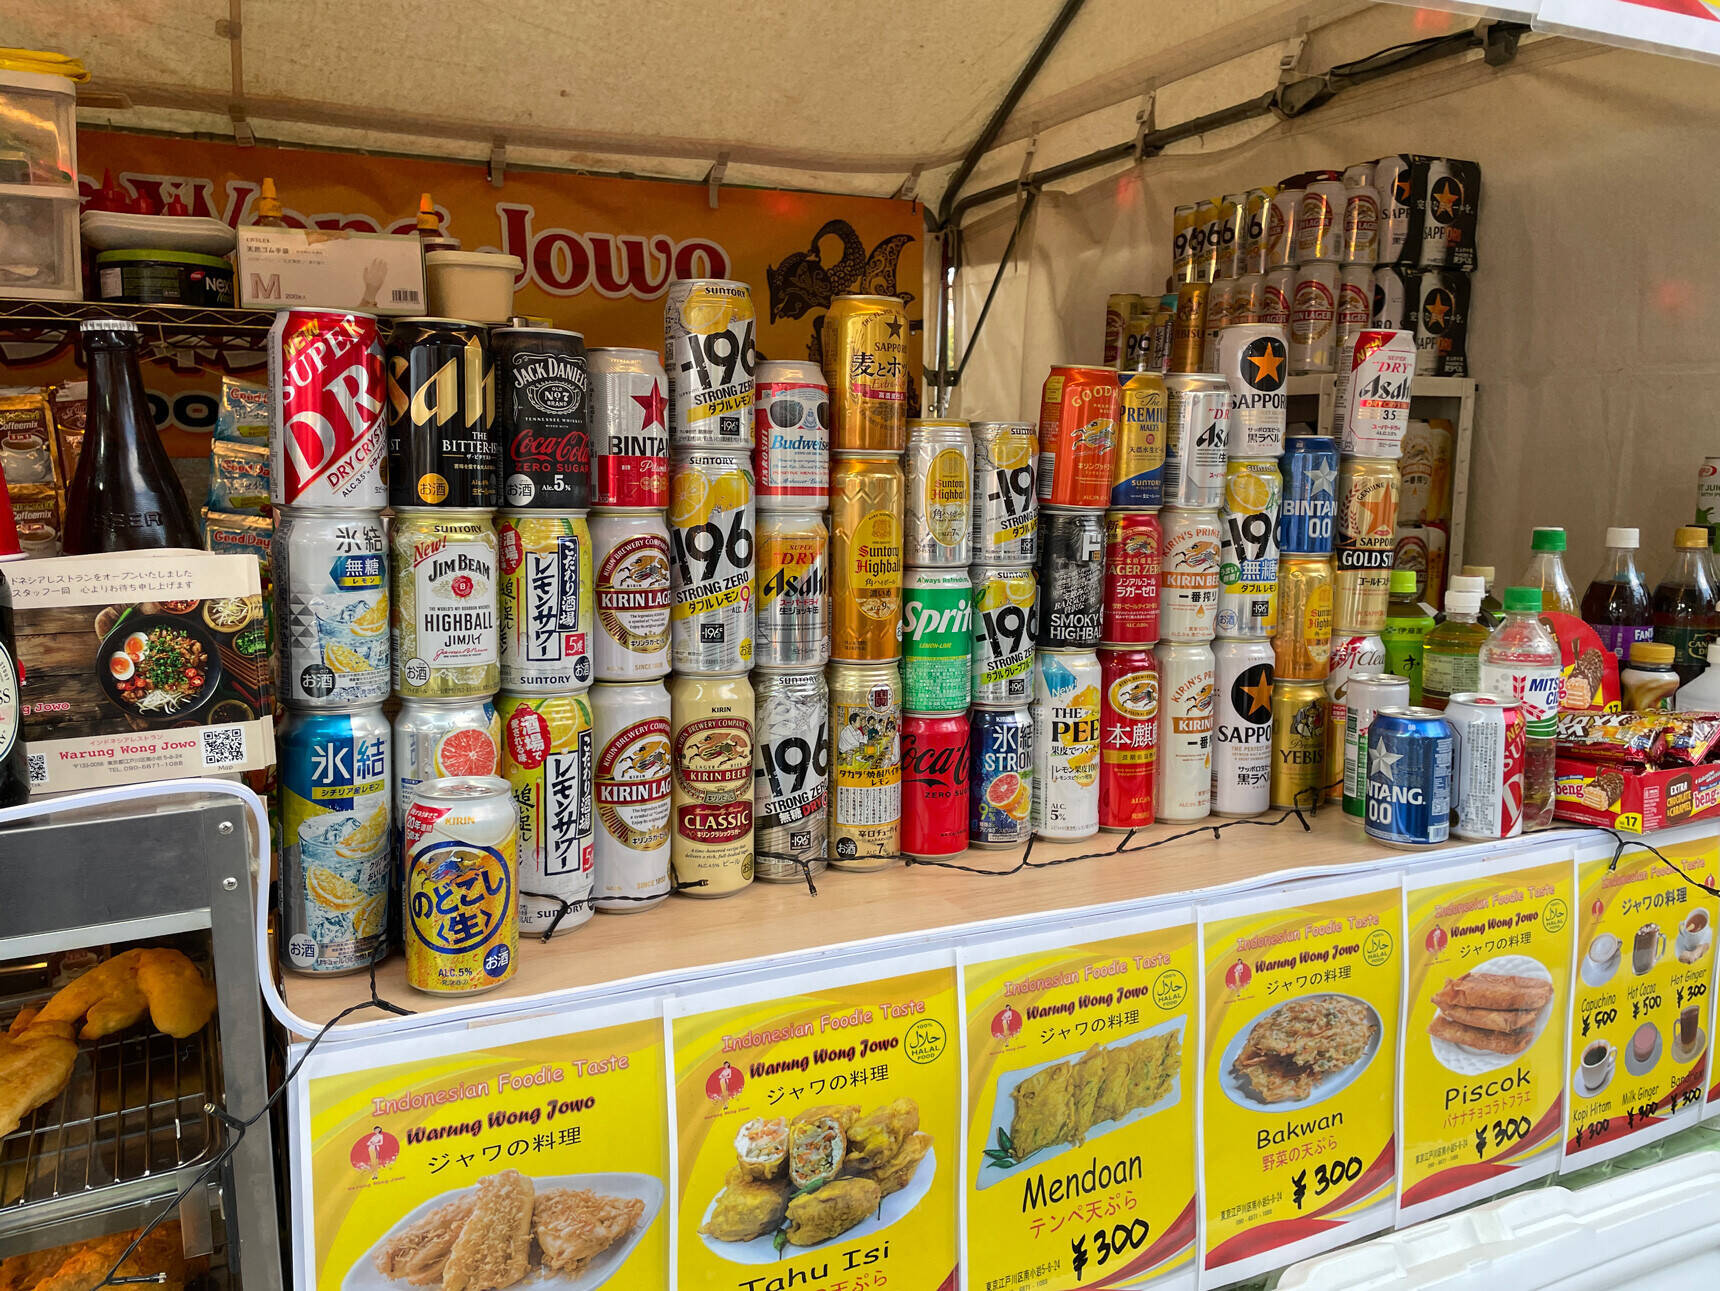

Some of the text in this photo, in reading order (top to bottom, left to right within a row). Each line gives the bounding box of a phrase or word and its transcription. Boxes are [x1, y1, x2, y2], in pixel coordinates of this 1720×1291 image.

[500, 202, 731, 300] Jowo
[250, 273, 281, 299] M
[705, 287, 746, 298] SUNTORY
[1305, 311, 1332, 320] LAGER
[1340, 313, 1368, 322] LAGER
[284, 318, 320, 360] NEW
[1357, 335, 1383, 362] NEW
[513, 360, 549, 388] JACK
[1373, 361, 1412, 373] DRY
[695, 387, 737, 405] STRONG
[472, 432, 487, 440] THE
[1247, 433, 1280, 443] 黒ラベル
[515, 464, 551, 472] ZERO
[689, 456, 734, 464] SUNTORY
[326, 460, 355, 488] DRY
[420, 479, 445, 496] お酒
[506, 483, 532, 497] お酒
[1357, 481, 1384, 502] GENUINE
[1308, 518, 1331, 538] 0.0
[214, 532, 246, 545] Good
[336, 526, 382, 553] 氷結
[670, 509, 753, 586] -196
[1162, 531, 1193, 557] KIRIN'S
[414, 536, 446, 562] New!
[604, 541, 644, 577] KIRIN BREWERY
[779, 552, 816, 565] DRY
[1342, 551, 1379, 566] GOLD
[345, 558, 379, 576] 無糖
[428, 553, 489, 582] JIM BEAM
[1241, 559, 1277, 582] 無糖
[560, 540, 577, 626] こだわり酒場
[676, 570, 749, 604] STRONG ZERO
[1116, 578, 1156, 586] ノンアルコール
[1167, 575, 1204, 585] KIRIN
[1241, 584, 1261, 593] ダブル
[602, 592, 645, 607] KIRIN
[1116, 587, 1156, 598] ラガーゼロ
[1178, 591, 1217, 603] 一番搾り
[532, 556, 557, 657] レモンサワー
[425, 612, 493, 632] HIGHBALL
[1050, 613, 1099, 625] SMOKY
[445, 633, 482, 647] JIMハイ
[987, 652, 1023, 671] STRONG
[302, 672, 332, 688] お酒
[407, 664, 427, 680] お酒
[520, 675, 571, 685] SUNTORY
[779, 676, 819, 685] SUNTORY
[1172, 675, 1201, 704] KIRIN'S
[34, 702, 70, 712] Jowo
[1052, 707, 1082, 718] THE
[689, 719, 745, 735] BREWERY COMPANY
[1179, 718, 1211, 731] KIRIN
[520, 714, 540, 761] 酒場で
[602, 725, 649, 767] KIRIN BREWERY
[60, 740, 196, 761] Warung Wong Jowo
[310, 737, 385, 784] 氷結
[690, 770, 747, 781] KIRIN BEER
[601, 783, 650, 802] KIRIN
[925, 791, 951, 799] ZERO
[1556, 782, 1584, 798] beng
[1670, 781, 1688, 795] EXTRA
[552, 751, 580, 869] レモンサワー
[765, 793, 809, 814] STRONG
[802, 800, 820, 817] DRY
[1369, 800, 1392, 824] 0.0
[444, 816, 476, 826] KIRIN
[684, 810, 750, 829] CLASSIC
[1050, 810, 1065, 821] 5%
[1625, 816, 1637, 827] 17
[837, 842, 856, 855] お酒
[412, 869, 504, 921] のどごし
[1434, 884, 1555, 920] Indonesian Foodie Taste
[1622, 887, 1687, 916] ジャワの料理
[1235, 914, 1380, 953] Indonesian Foodie Taste
[1450, 910, 1539, 940] Warung Wong Jowo
[289, 942, 315, 958] お酒
[1459, 932, 1533, 959] ジャワの料理
[485, 946, 509, 970] お酒
[1254, 941, 1360, 974] Warung Wong Jowo
[438, 967, 472, 977] ALC.5%
[1004, 951, 1171, 998] Indonesian Foodie Taste
[1267, 965, 1352, 996] ジャワの料理
[1671, 969, 1707, 985] Hot Ginger
[1158, 994, 1182, 1003] HALAL
[1627, 982, 1656, 1000] Hot Cocoa
[1026, 983, 1149, 1022] Warung Wong Jowo
[1581, 993, 1616, 1013] Capuchino
[721, 999, 926, 1054] Indonesian Foodie Taste
[1040, 1009, 1140, 1046] ジャワの料理
[749, 1036, 899, 1079] Warung Wong Jowo
[910, 1045, 941, 1057] HALAL
[917, 1053, 935, 1061] FOOD
[371, 1054, 629, 1118] Indonesian Foodie Taste
[767, 1064, 889, 1106] ジャワの料理
[1444, 1067, 1532, 1111] Piscok
[1622, 1085, 1660, 1104] Milk Ginger
[406, 1095, 595, 1146] Warung Wong Jowo
[1573, 1100, 1612, 1122] Kopi Hitam
[1257, 1111, 1344, 1151] Bakwan
[427, 1126, 582, 1175] ジャワの料理
[1262, 1134, 1339, 1173] 野菜の天ぷら
[1021, 1155, 1143, 1214] Mendoan
[1029, 1190, 1138, 1240] テンペ天ぷら
[738, 1241, 889, 1291] Tahu Isi
